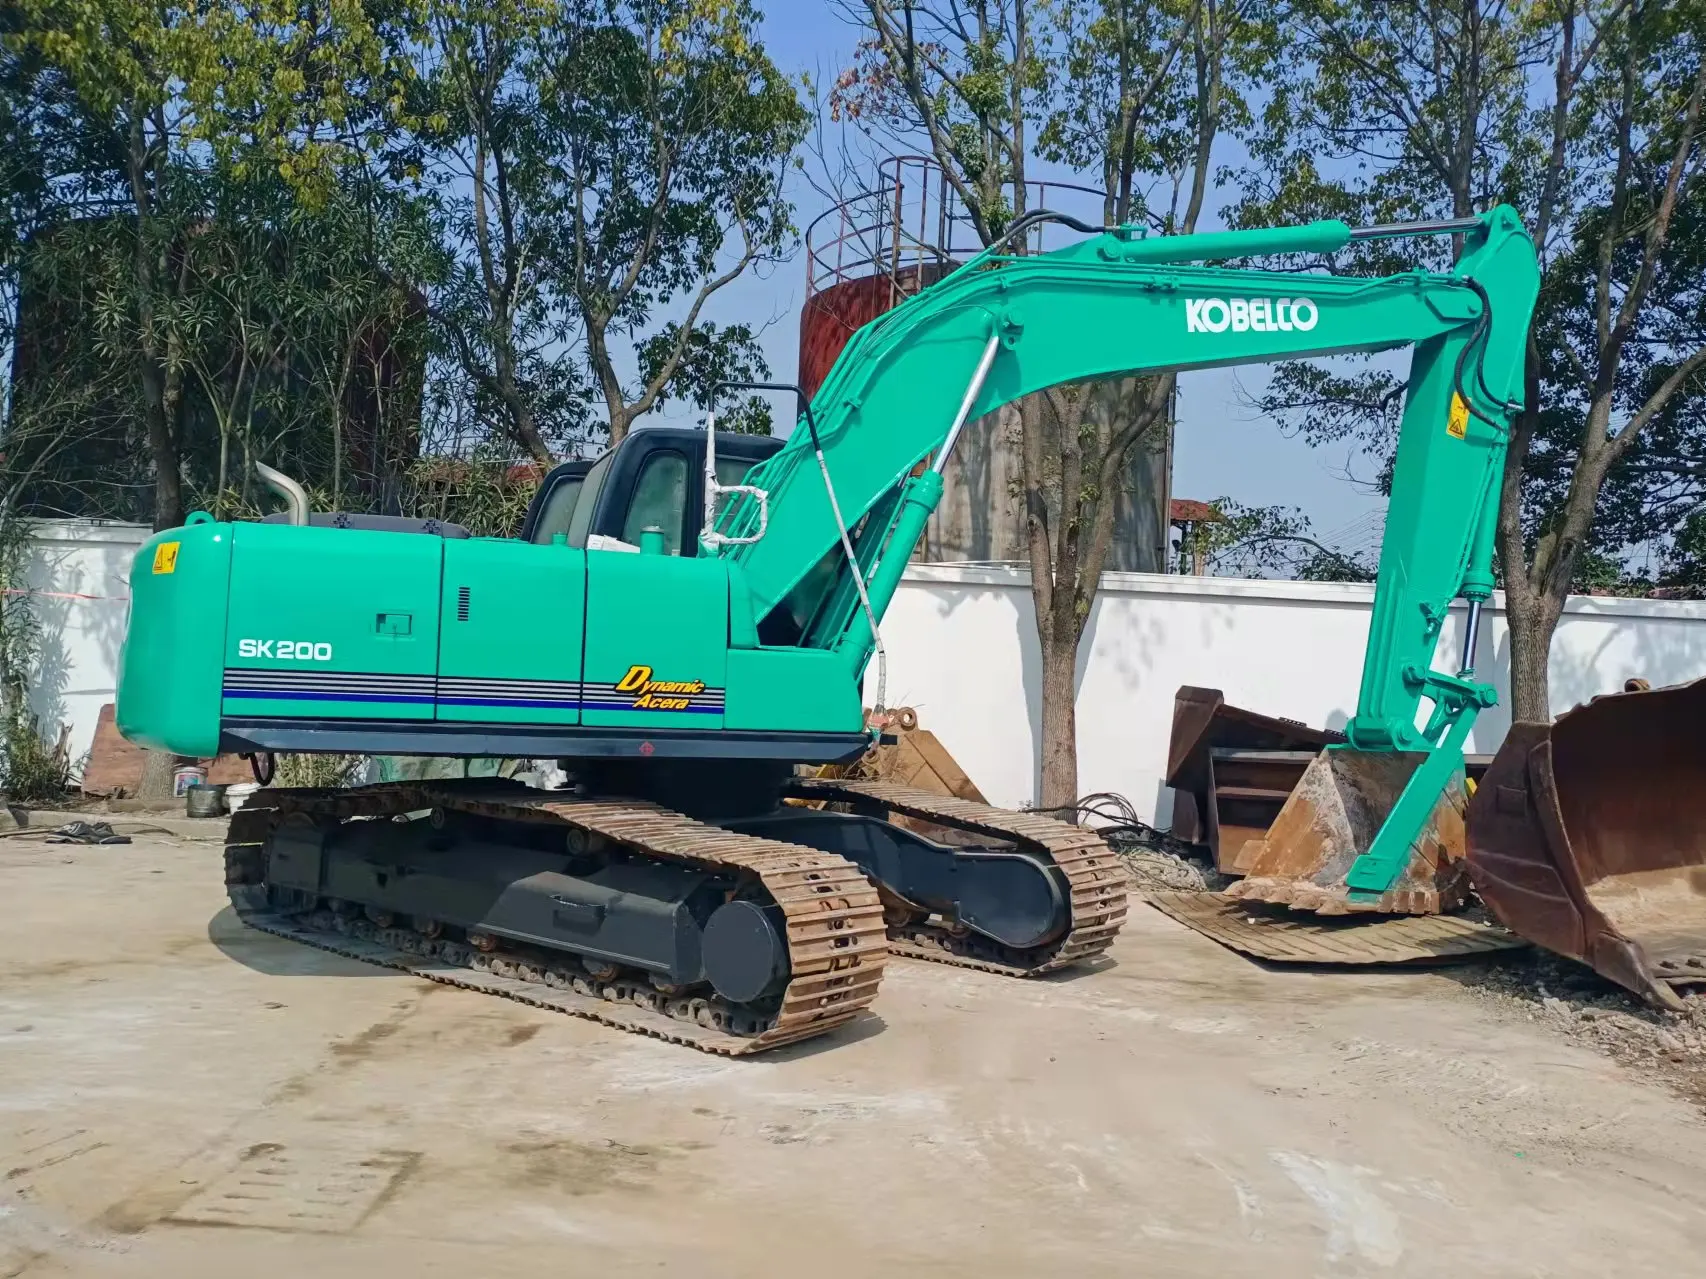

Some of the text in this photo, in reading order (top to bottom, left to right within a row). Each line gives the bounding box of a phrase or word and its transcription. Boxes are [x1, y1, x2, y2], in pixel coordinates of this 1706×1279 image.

[1185, 298, 1318, 333] KOBELCO
[615, 665, 705, 695] Dynamic
[632, 693, 690, 709] Acera
